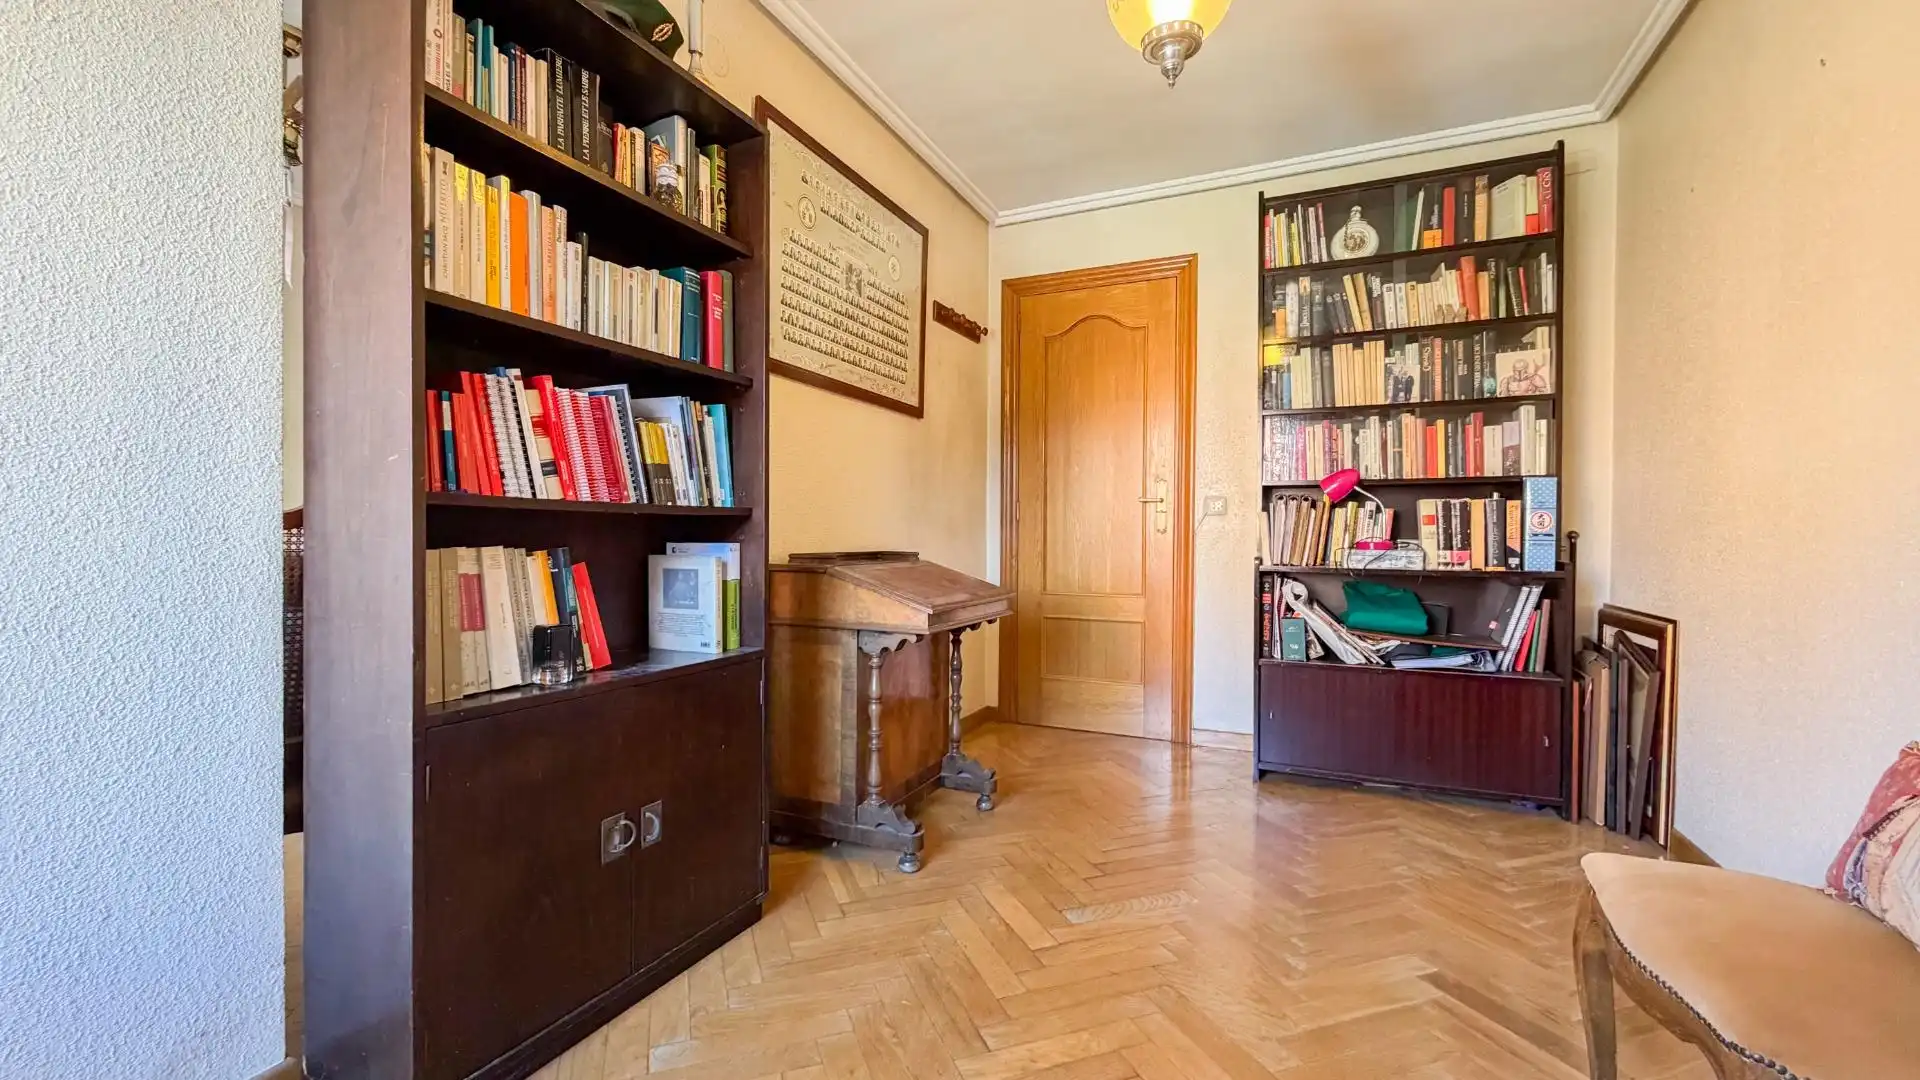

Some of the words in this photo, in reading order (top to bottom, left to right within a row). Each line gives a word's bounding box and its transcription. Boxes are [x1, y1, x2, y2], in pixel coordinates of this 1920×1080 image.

[581, 68, 589, 96] SABRE
[581, 96, 589, 107] LE
[556, 97, 565, 136] PARFAITE
[581, 107, 589, 119] ET
[581, 119, 590, 148] PIERRE
[557, 138, 565, 150] LA
[582, 149, 590, 161] LA
